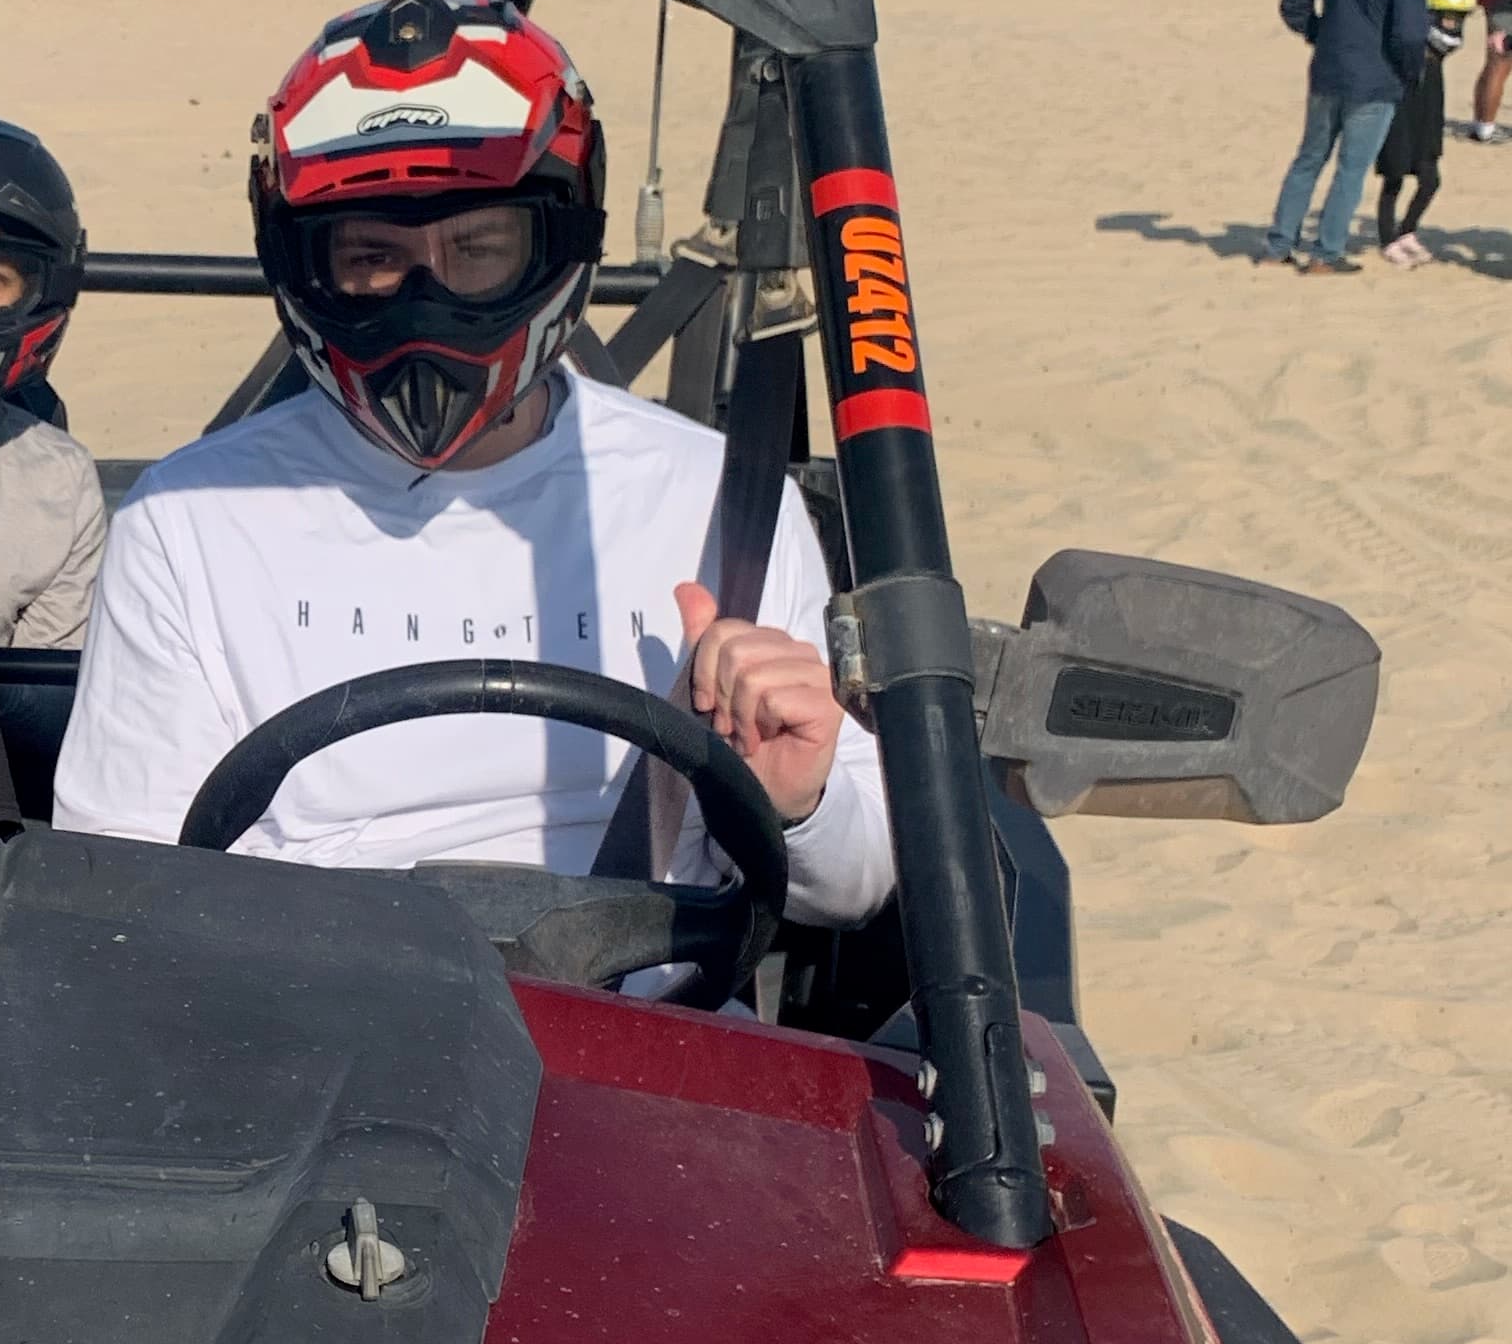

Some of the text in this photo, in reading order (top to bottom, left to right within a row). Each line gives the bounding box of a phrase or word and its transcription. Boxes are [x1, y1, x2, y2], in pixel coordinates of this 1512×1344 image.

[840, 216, 917, 375] UZ412
[298, 600, 645, 644] HANG TEN
